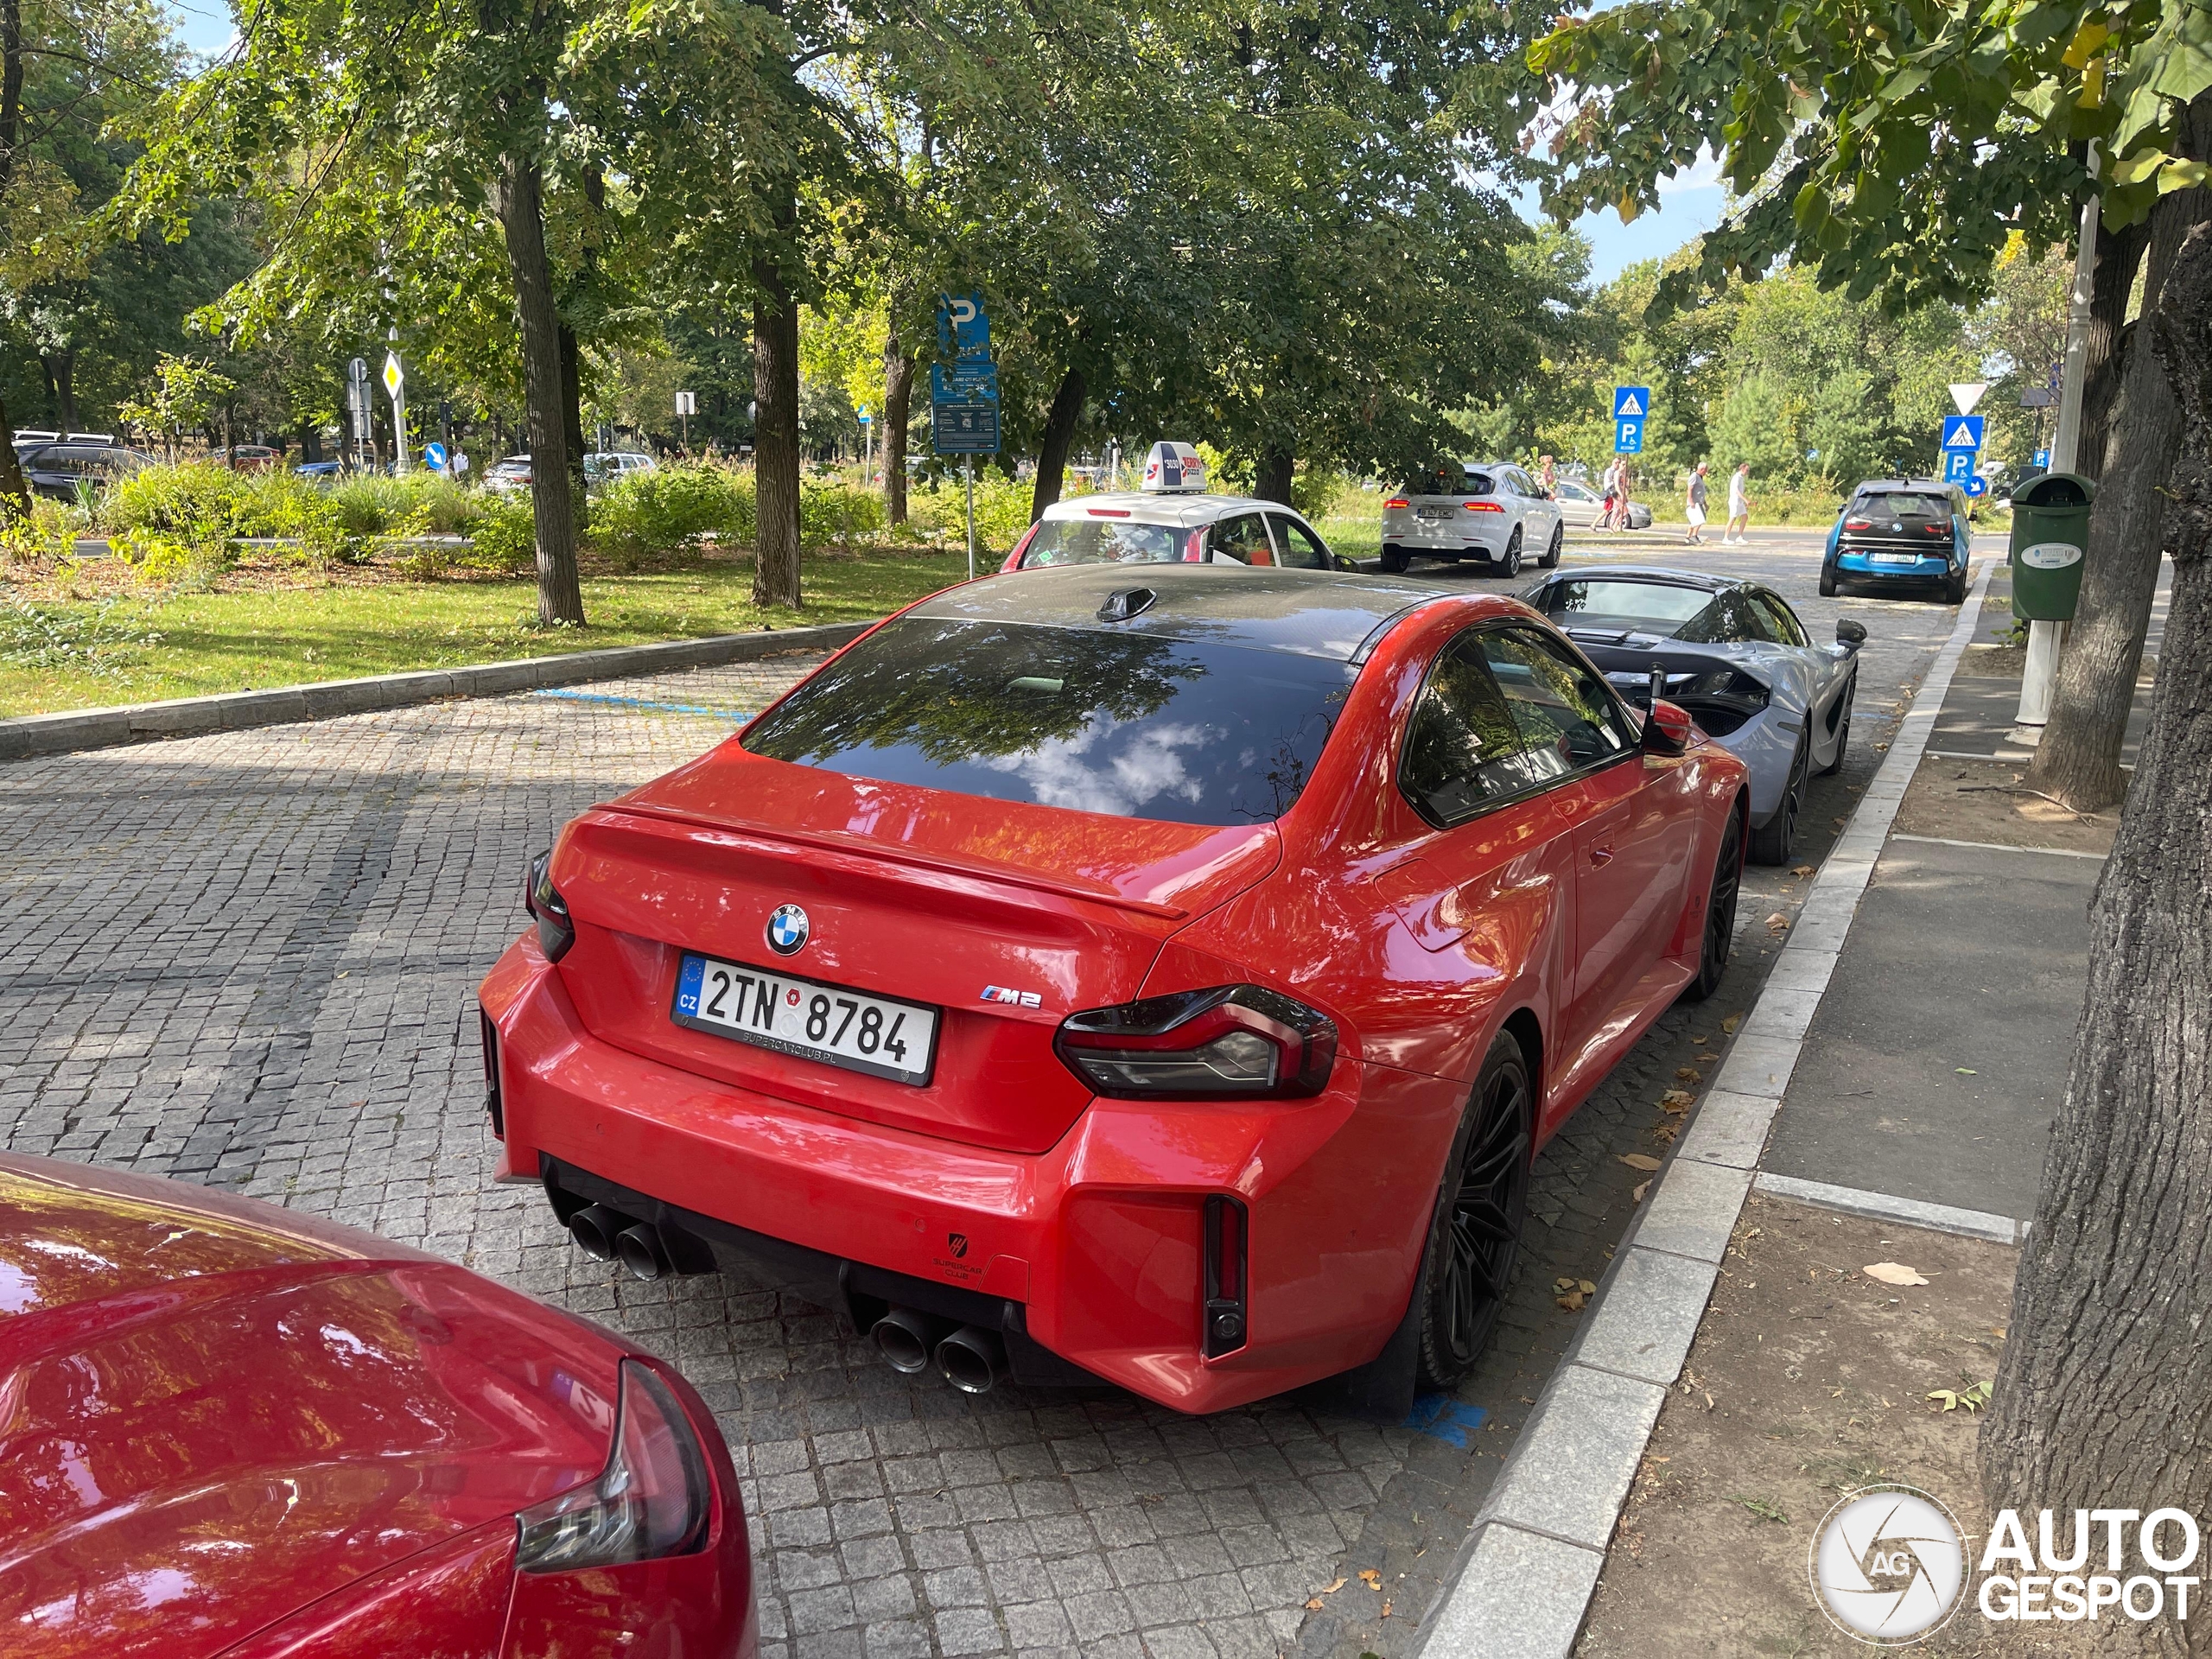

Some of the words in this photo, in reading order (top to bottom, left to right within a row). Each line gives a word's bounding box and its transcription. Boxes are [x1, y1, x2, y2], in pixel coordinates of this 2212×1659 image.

[950, 300, 976, 333] P
[1622, 423, 1637, 442] P
[1952, 455, 1968, 475] P
[2037, 453, 2045, 463] P
[774, 906, 806, 925] BMW
[680, 994, 696, 1010] CZ
[995, 988, 1042, 1009] M2
[707, 970, 779, 1030] 2TN
[806, 995, 907, 1063] 8784
[742, 1032, 836, 1064] SUPERCARCLUB.PL
[933, 1258, 982, 1274] SUPERCAR
[945, 1269, 969, 1280] CLUB
